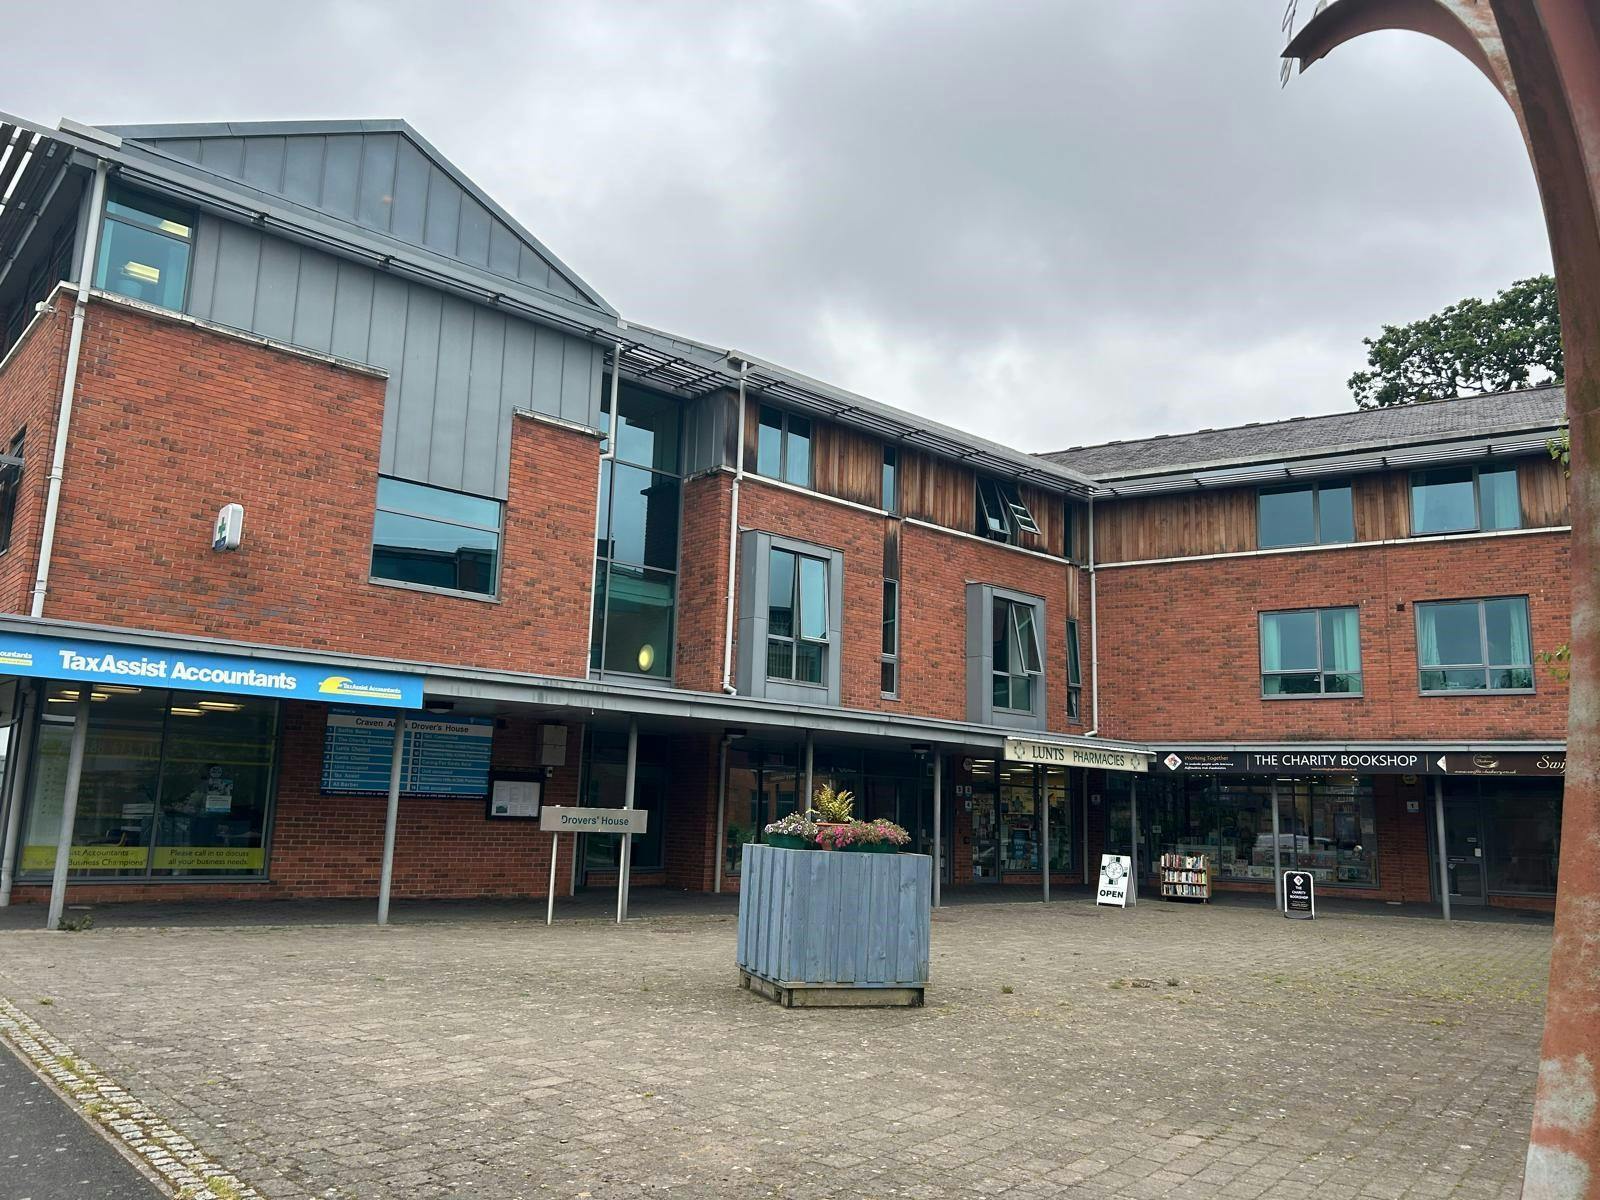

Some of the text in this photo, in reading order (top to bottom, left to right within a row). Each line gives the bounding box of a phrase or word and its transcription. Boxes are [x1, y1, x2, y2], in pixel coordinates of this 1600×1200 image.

[59, 650, 297, 690] TaxAssist Accountants
[355, 718, 384, 727] Craven
[411, 722, 442, 731] Drover's
[445, 725, 469, 733] House
[1032, 745, 1125, 767] LUNTS PHARMACIES
[1254, 755, 1417, 767] THE CHARITY BOOKSHOP
[601, 816, 629, 826] House
[82, 849, 129, 857] Accountants
[170, 849, 193, 857] Please
[194, 849, 206, 857] call
[1099, 889, 1124, 898] OPEN
